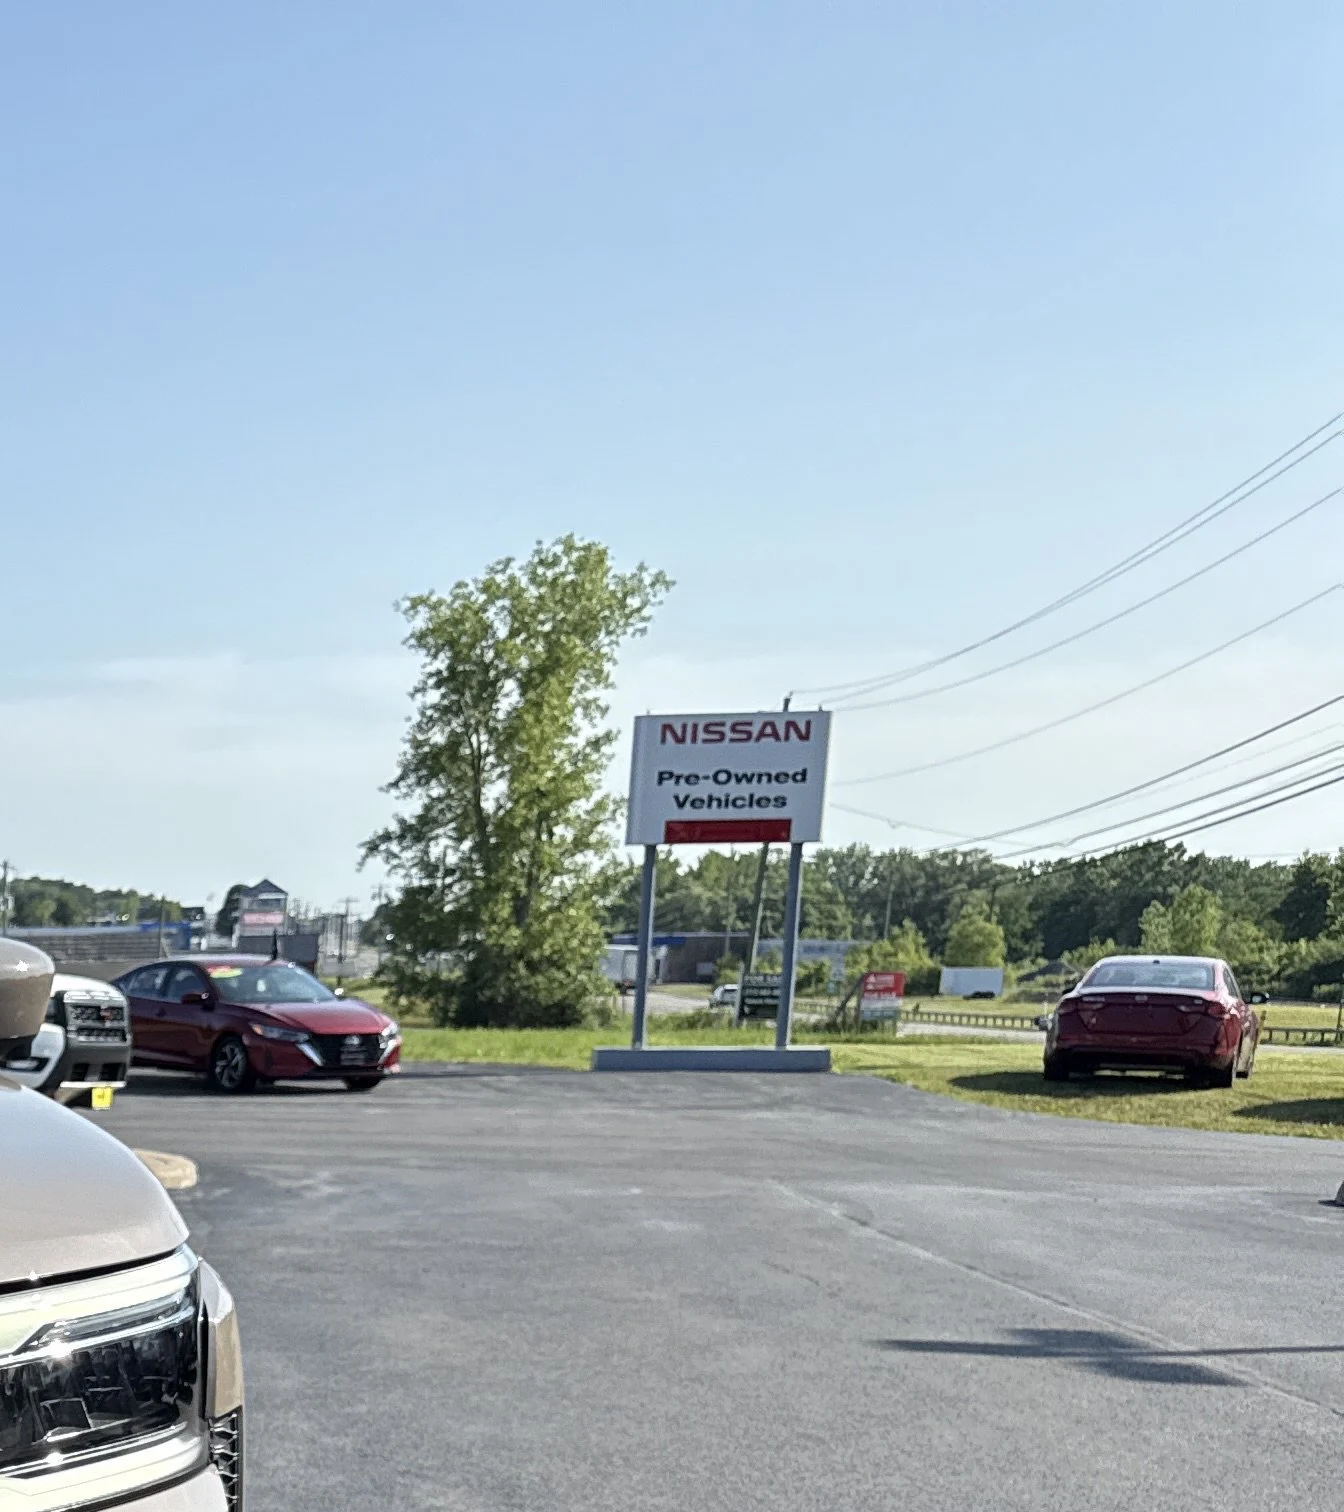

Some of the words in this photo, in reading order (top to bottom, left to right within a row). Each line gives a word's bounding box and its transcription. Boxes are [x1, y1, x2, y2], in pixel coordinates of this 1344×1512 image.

[660, 719, 812, 745] NISSAN
[657, 768, 808, 786] Pre-Owned
[673, 793, 788, 810] Vehicles
